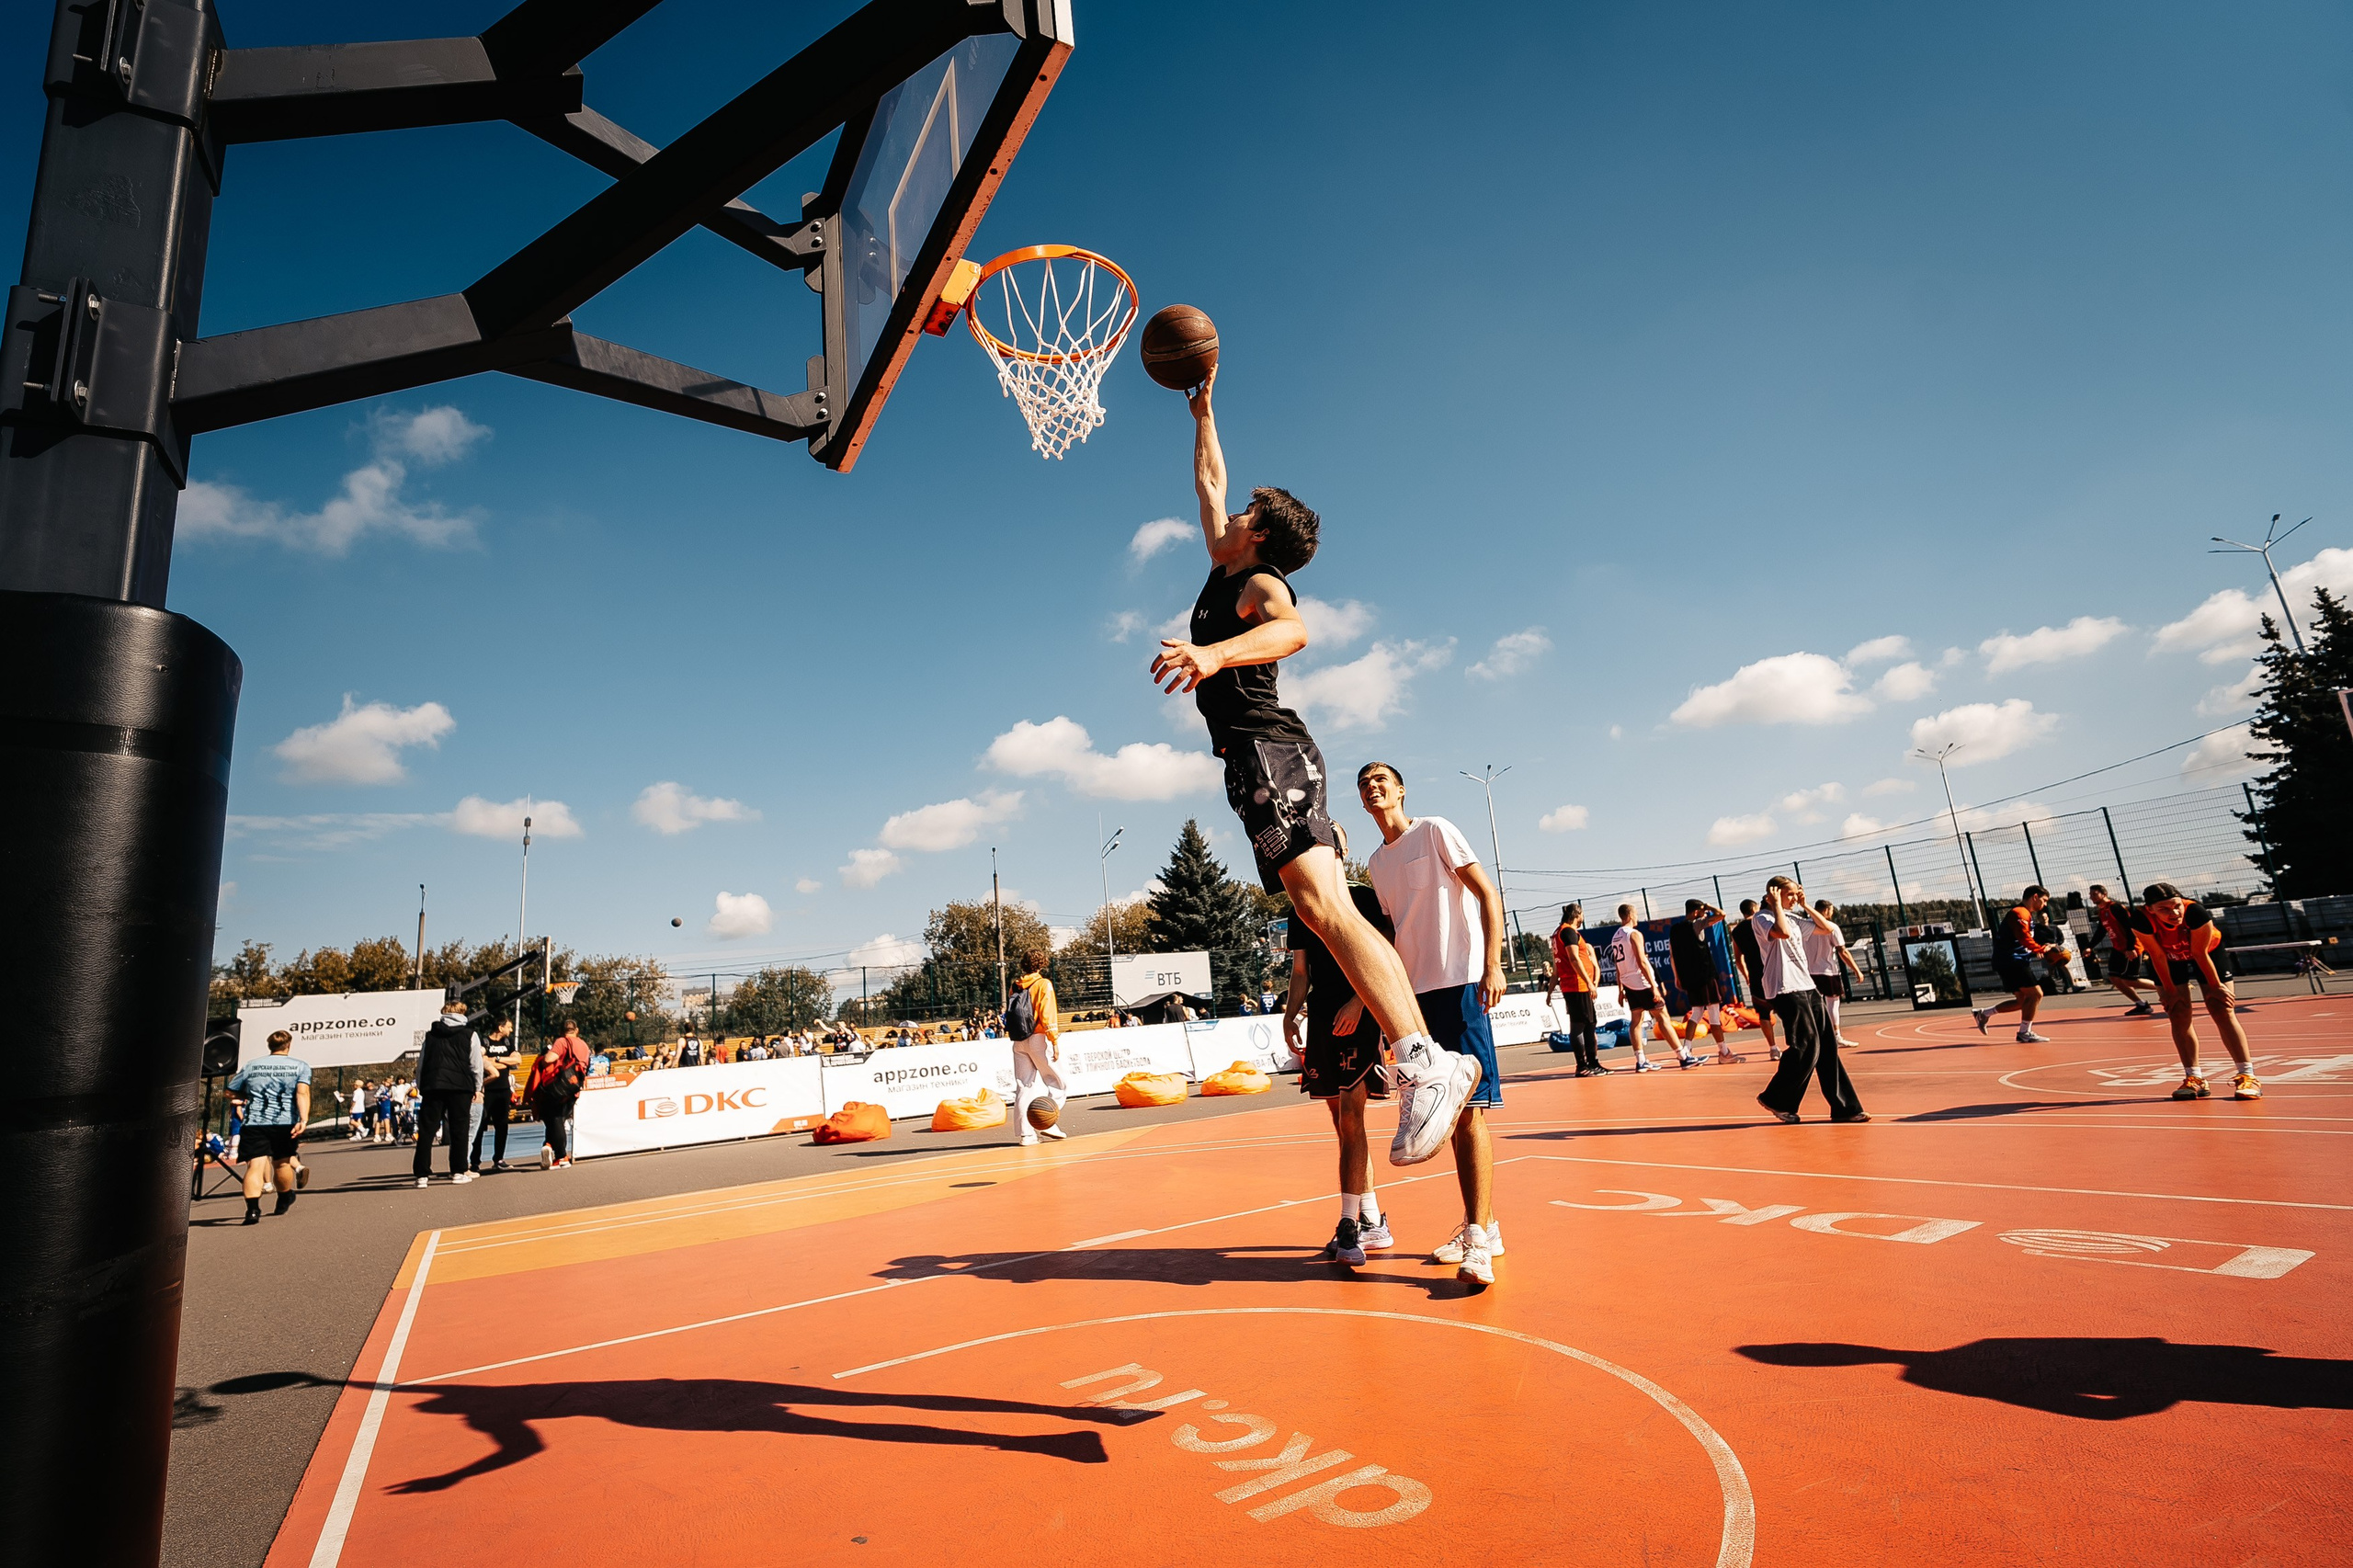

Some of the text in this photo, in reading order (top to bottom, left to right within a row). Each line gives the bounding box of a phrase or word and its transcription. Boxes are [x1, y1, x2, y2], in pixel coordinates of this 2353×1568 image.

[1157, 971, 1182, 986] ВТБ
[289, 1017, 396, 1034] appzone.co
[301, 1030, 383, 1041] магазин техники
[873, 1062, 978, 1085] appzone.co
[887, 1078, 969, 1094] магазин техники
[684, 1087, 767, 1115] DKC
[1548, 1188, 1985, 1245] DKC
[1058, 1361, 1434, 1528] dkc.ru
